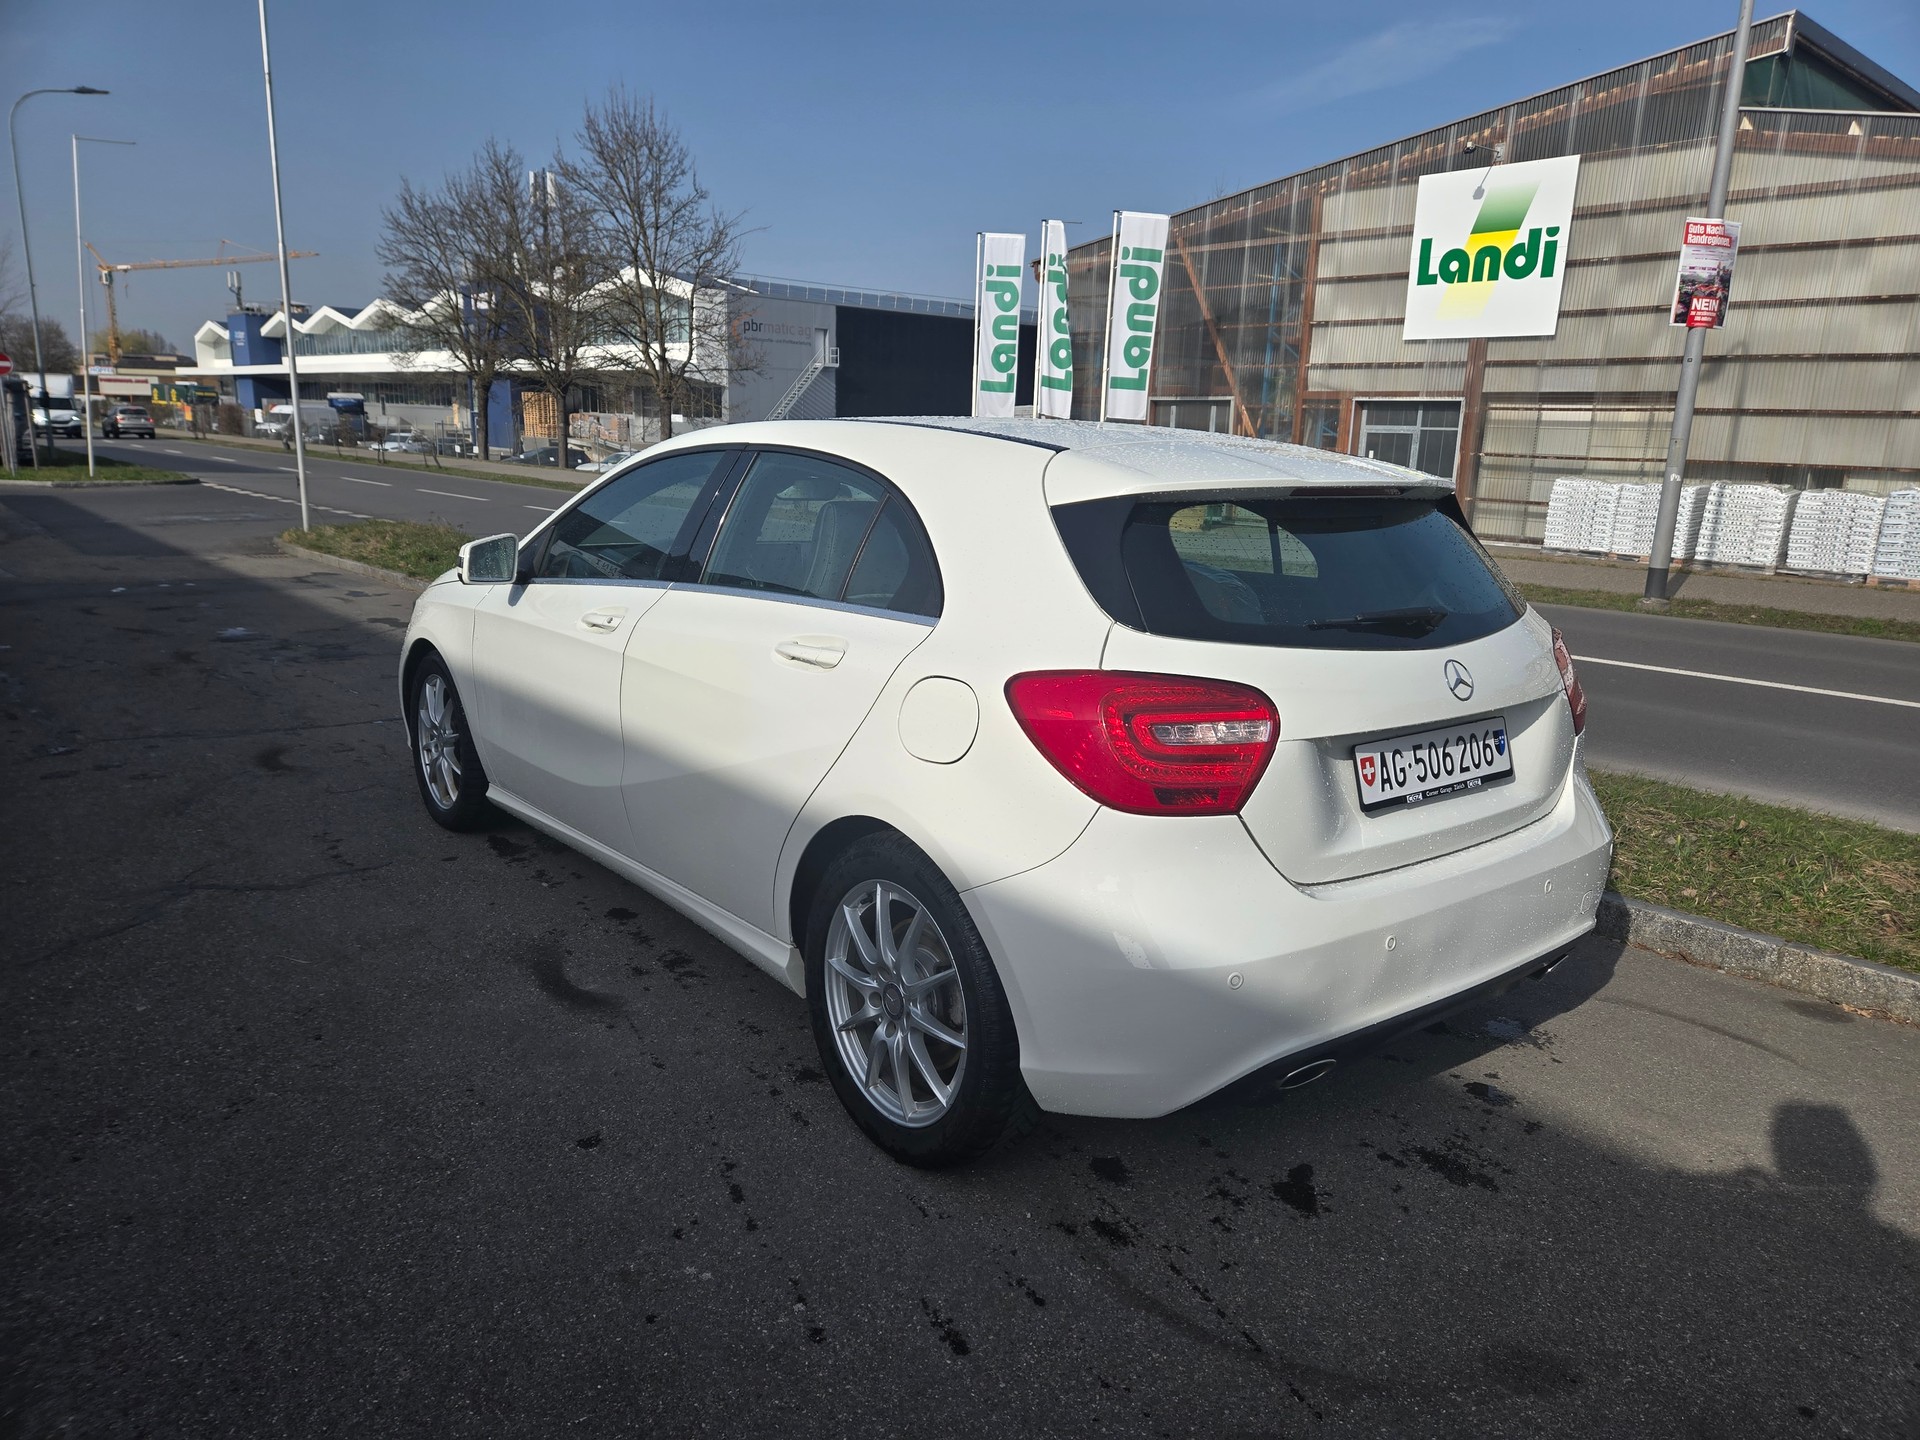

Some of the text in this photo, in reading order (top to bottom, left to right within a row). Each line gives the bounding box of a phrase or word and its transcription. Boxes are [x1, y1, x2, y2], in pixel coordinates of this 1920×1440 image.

[1688, 224, 1704, 234] Gute
[1417, 226, 1560, 285] Landi
[1110, 246, 1162, 391] Landi
[1691, 298, 1719, 312] NEIN
[743, 319, 812, 340] pbrmatic ag
[980, 264, 1021, 393] Landi
